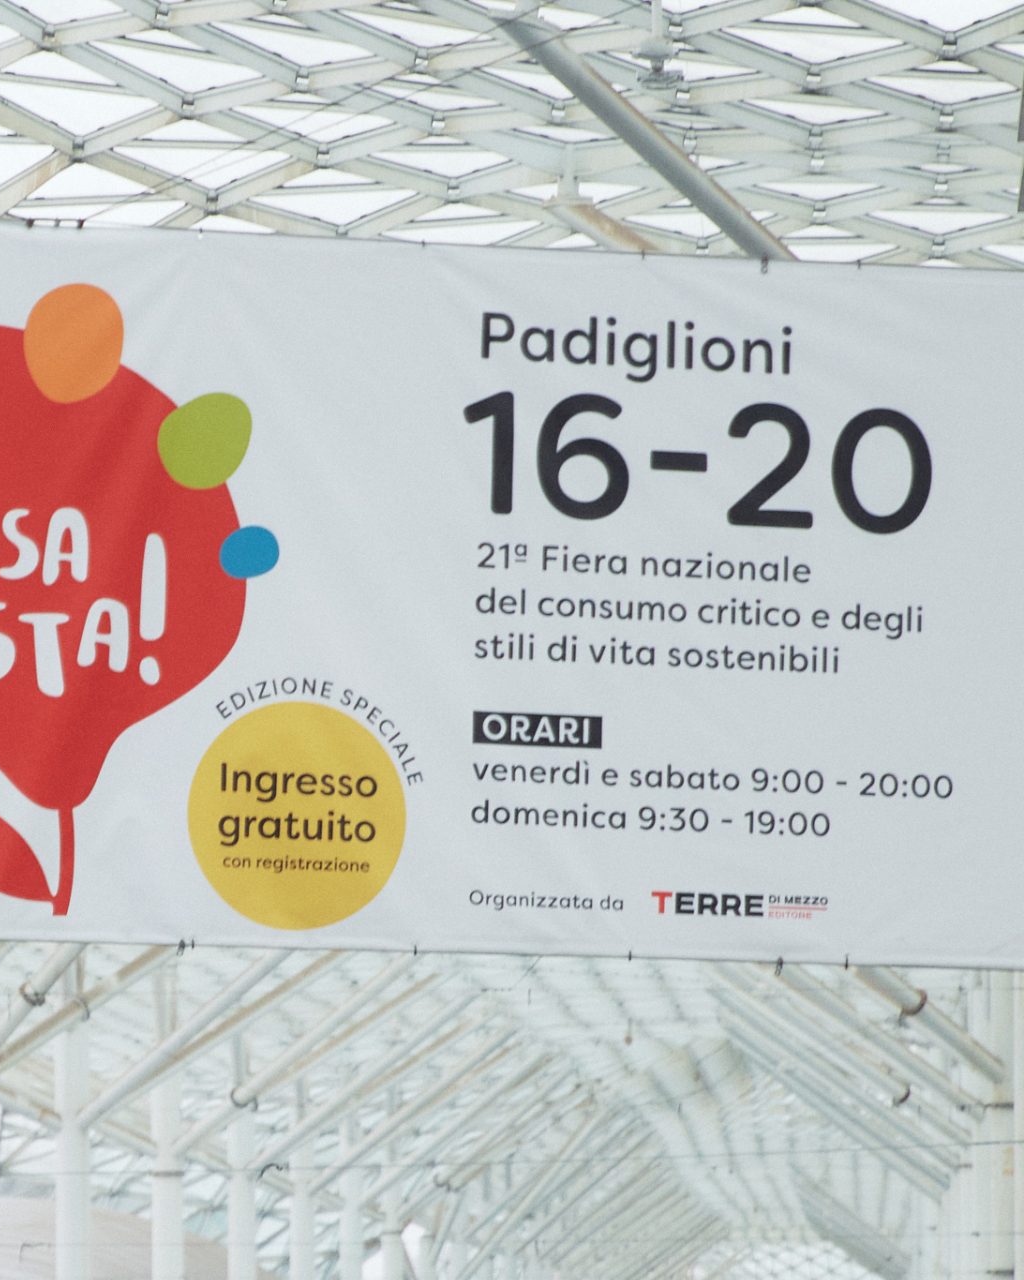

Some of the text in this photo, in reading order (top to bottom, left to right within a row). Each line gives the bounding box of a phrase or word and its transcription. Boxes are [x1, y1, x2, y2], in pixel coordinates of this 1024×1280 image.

[480, 312, 793, 383] Padiglioni
[541, 545, 628, 575] Fiera
[640, 553, 812, 584] nazionale
[475, 587, 924, 640] del consumo critico e degli
[474, 632, 840, 674] stili di vita sostenibili
[215, 676, 425, 787] EDIZIONE SPECIALE
[481, 714, 591, 745] ORARI
[220, 762, 378, 803] Ingresso
[472, 760, 591, 786] venerdì
[601, 766, 619, 787] e
[629, 763, 741, 791] sabato
[750, 767, 826, 795] 9:00
[859, 772, 954, 800] 20:00
[218, 810, 377, 848] gratuito
[471, 799, 627, 830] domenica
[638, 805, 710, 833] 9:30
[743, 810, 832, 837] 19:00
[222, 855, 371, 874] con registrazione
[468, 889, 624, 912] Organizzata da
[651, 891, 765, 918] TERRE
[768, 895, 829, 906] DI MEZZO
[768, 911, 813, 921] EDITORE
